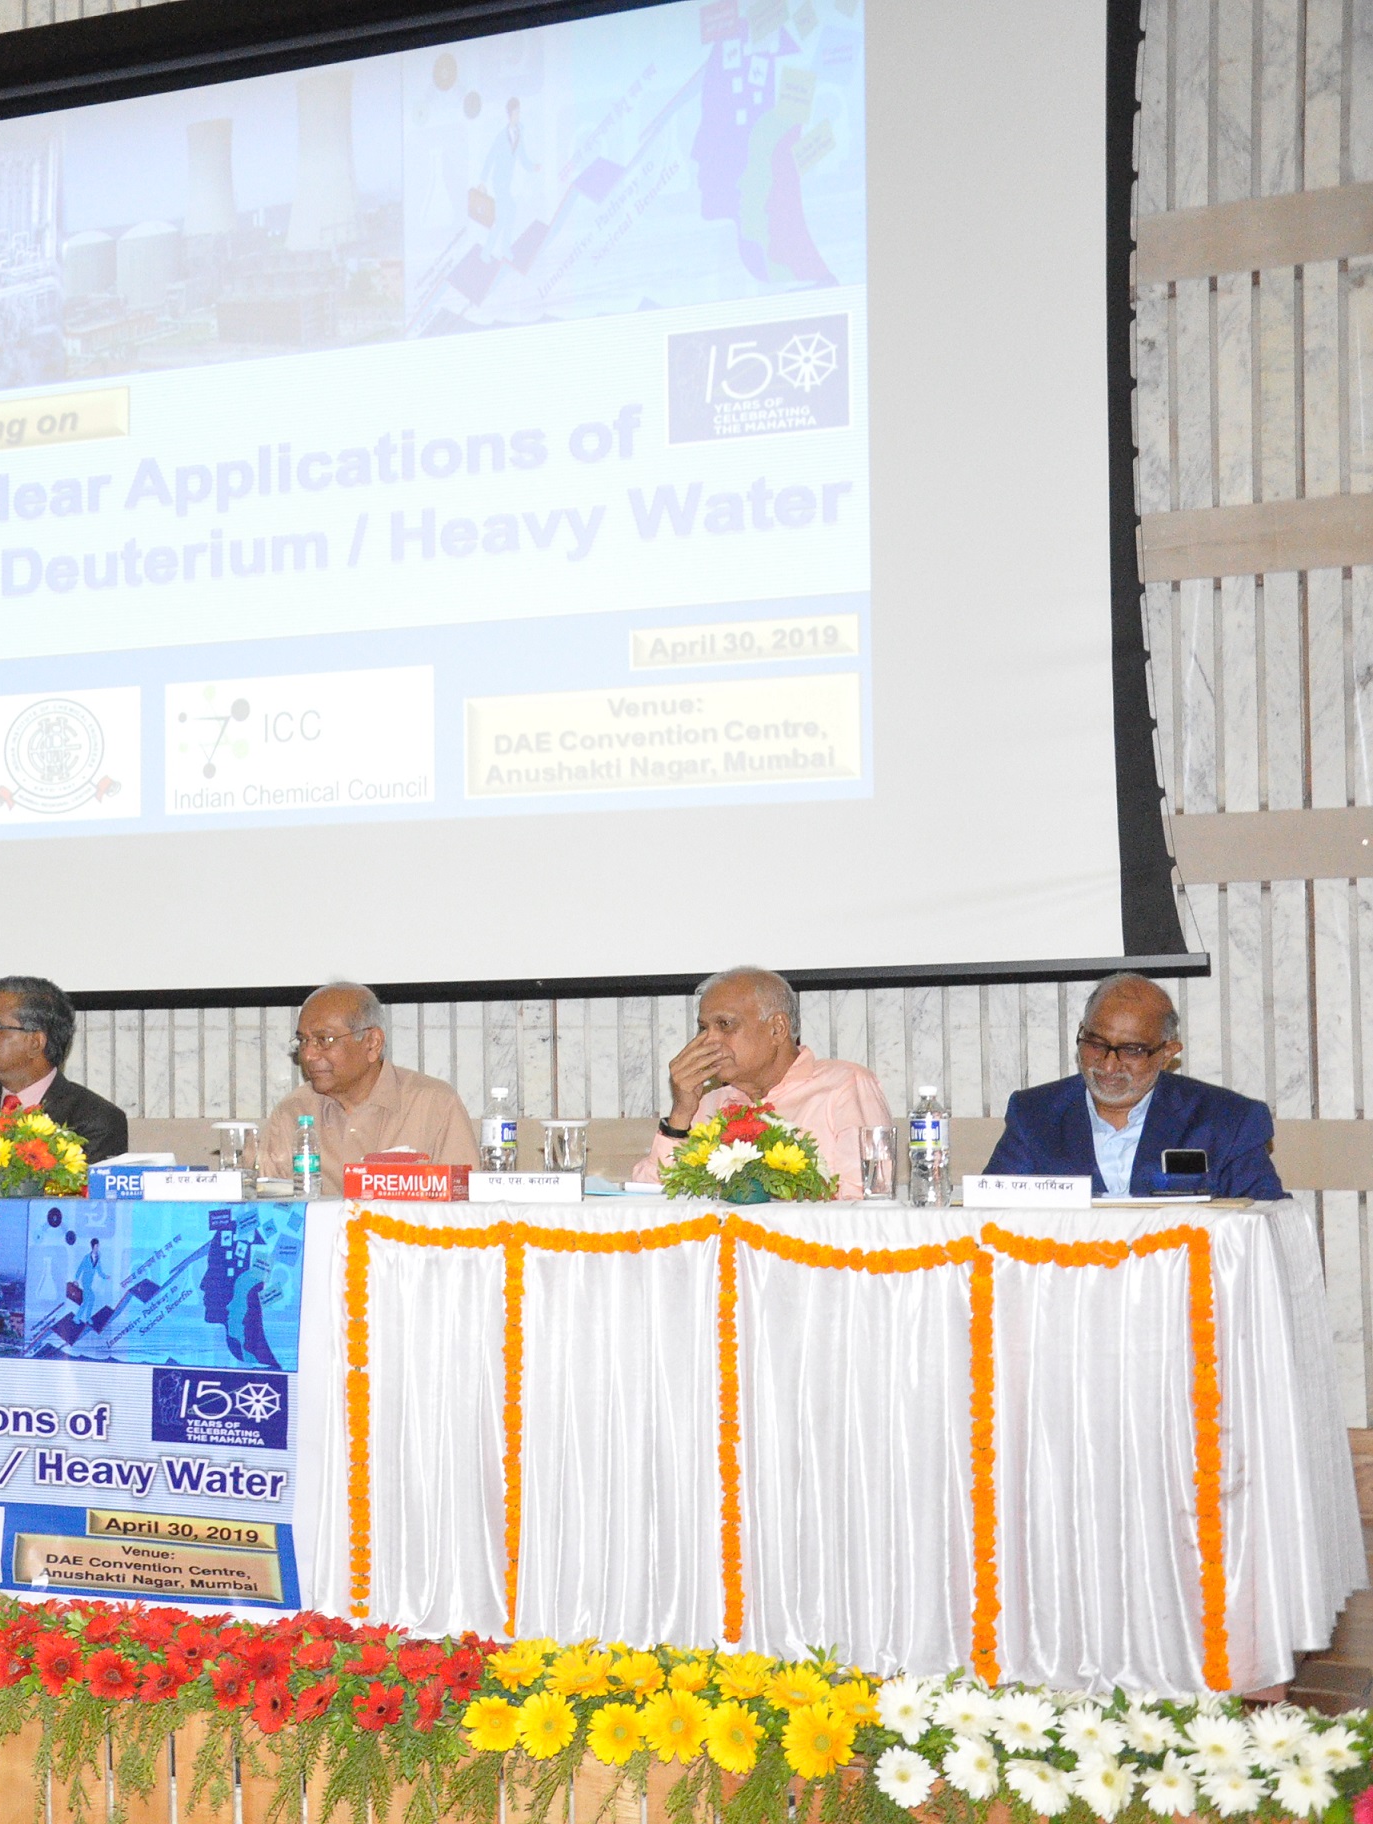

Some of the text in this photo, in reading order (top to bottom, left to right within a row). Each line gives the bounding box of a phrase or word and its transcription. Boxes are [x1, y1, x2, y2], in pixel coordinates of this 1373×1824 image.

[713, 405, 810, 424] CELEBRATING
[714, 398, 784, 414] YEARS OF
[37, 411, 79, 434] on
[714, 415, 817, 435] THE MAHATMA
[124, 426, 549, 517] Applications
[569, 404, 642, 464] of
[1, 525, 328, 599] Deuterium
[390, 504, 607, 562] Heavy
[628, 477, 853, 541] Water
[649, 625, 839, 662] April 30, 2019
[607, 695, 704, 719] Venue:
[262, 709, 321, 743] ICC
[494, 716, 828, 756] DAE Convention Centre,
[485, 746, 836, 786] Anushakti Nagar, Mumbai
[174, 776, 428, 810] Indian Chemical Council
[361, 1174, 447, 1191] PREMIUM
[69, 1406, 109, 1437] of
[186, 1427, 260, 1438] CELEBRATING
[187, 1419, 241, 1429] YEARS OF
[187, 1434, 265, 1445] THE MAHATMA
[38, 1452, 154, 1495] Heavy
[166, 1459, 285, 1498] Water
[105, 1517, 259, 1544] April 30, 2019
[46, 1553, 251, 1580] DAE Convention Centre,
[121, 1545, 175, 1561] Venue:
[42, 1566, 259, 1593] Anushakti Nagar, Mumbai
